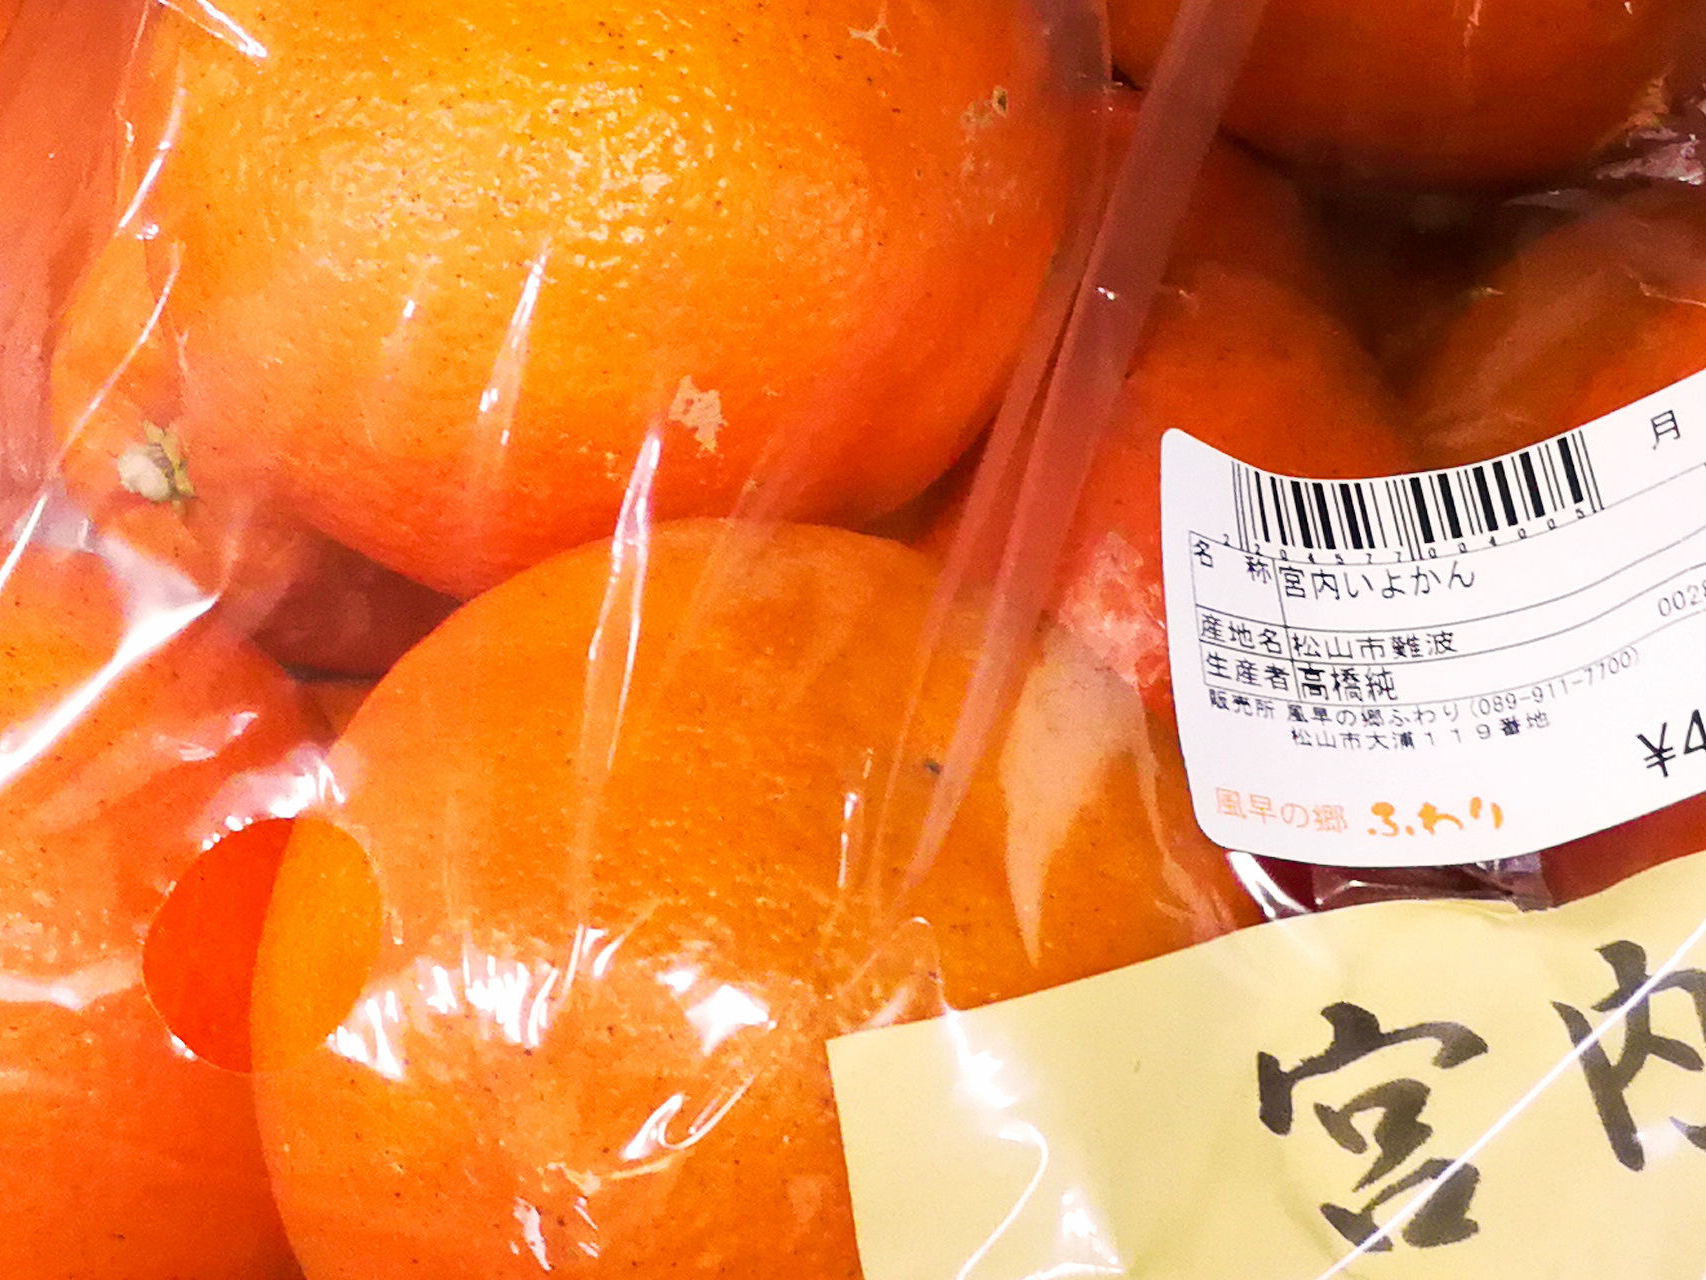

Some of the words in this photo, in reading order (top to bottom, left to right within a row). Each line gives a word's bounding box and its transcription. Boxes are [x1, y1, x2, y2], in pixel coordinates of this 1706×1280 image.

[1649, 409, 1681, 450] 月
[1278, 560, 1475, 601] 宮内いよかん
[1200, 613, 1283, 655] 産地名
[1292, 630, 1458, 660] 松山市難波
[1205, 651, 1290, 692] 生産者
[1216, 787, 1349, 834] 風早の郷
[1367, 796, 1504, 838] ふわり
